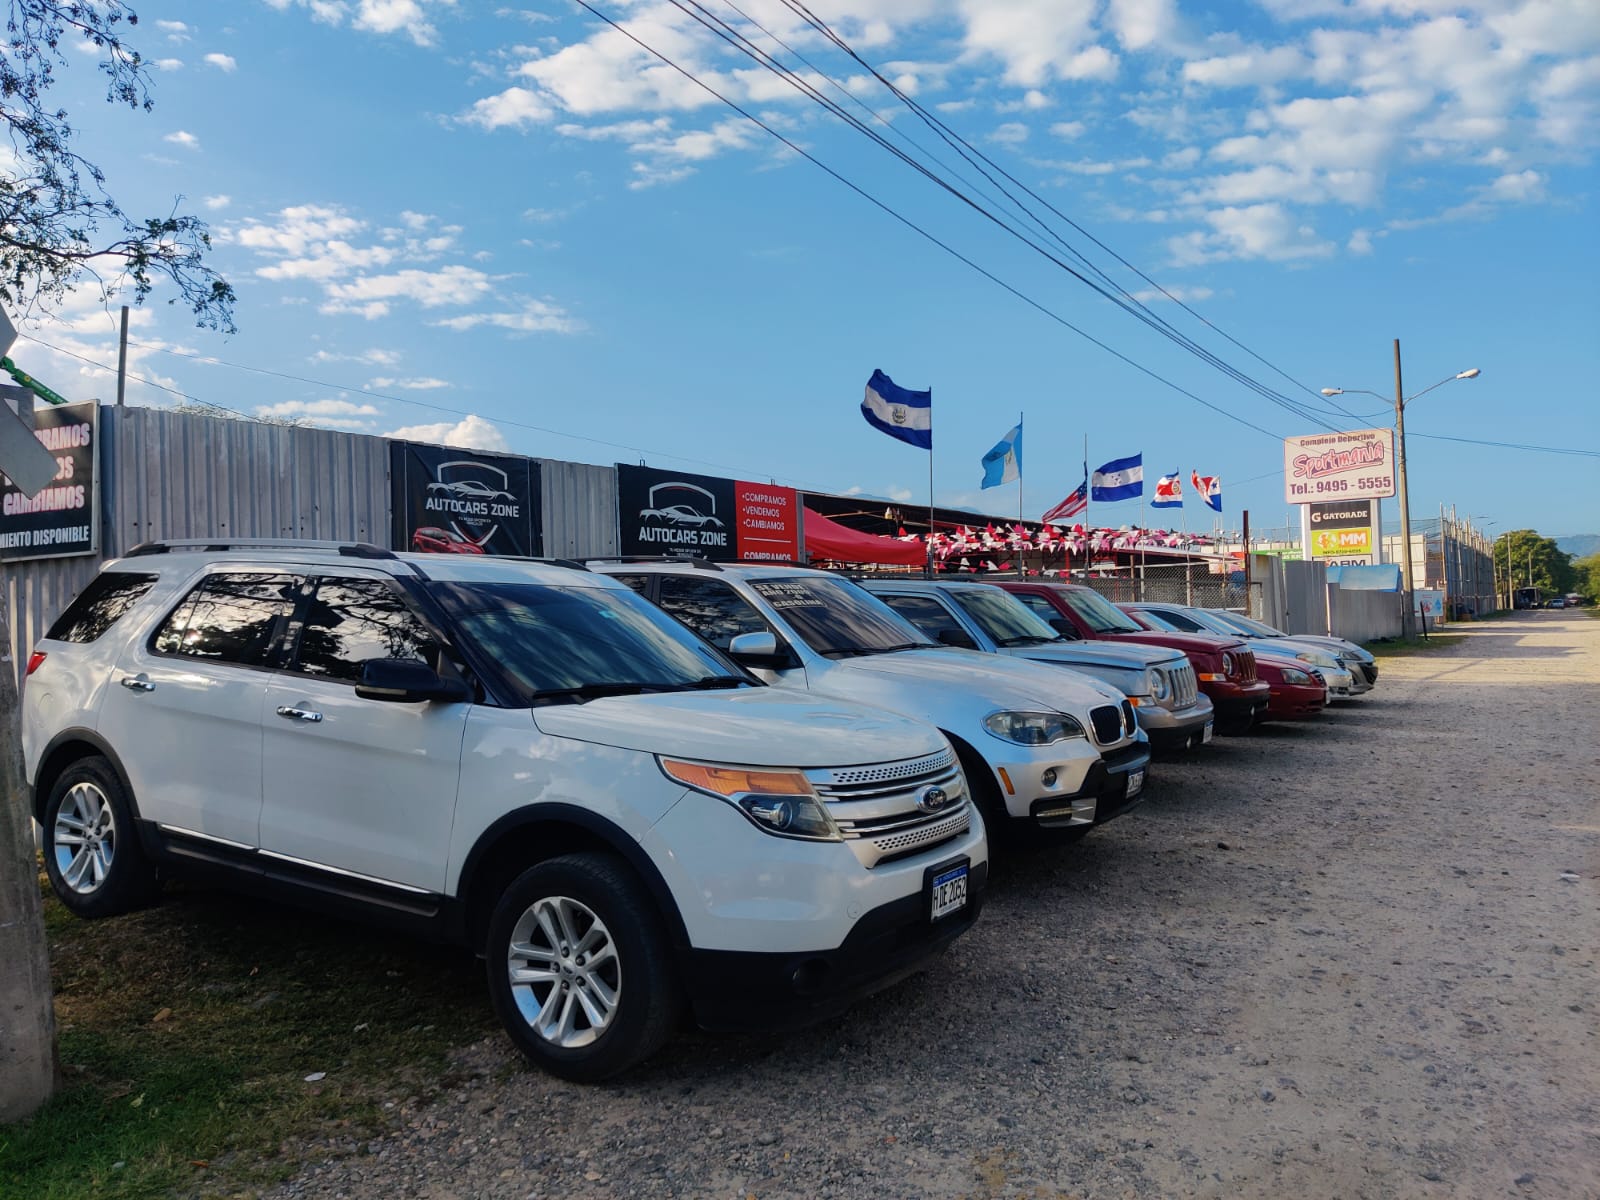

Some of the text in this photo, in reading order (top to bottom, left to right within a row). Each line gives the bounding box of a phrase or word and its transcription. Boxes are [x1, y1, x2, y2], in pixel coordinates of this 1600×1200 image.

[34, 423, 90, 451] RAMOS
[1300, 433, 1375, 447] Complejo Deportivo
[1293, 441, 1385, 479] Sportmania
[1316, 479, 1348, 493] 9495
[1358, 476, 1391, 490] 5555
[425, 497, 519, 518] AUTOCARS ZONE
[744, 492, 787, 506] COMPRAMOS
[745, 506, 780, 518] VENDEMOS
[1322, 510, 1368, 521] GATORADE
[745, 518, 785, 531] CAMBIAMOS
[33, 526, 90, 547] DISPONIBLE
[638, 526, 728, 547] AUTOCARS ZONE
